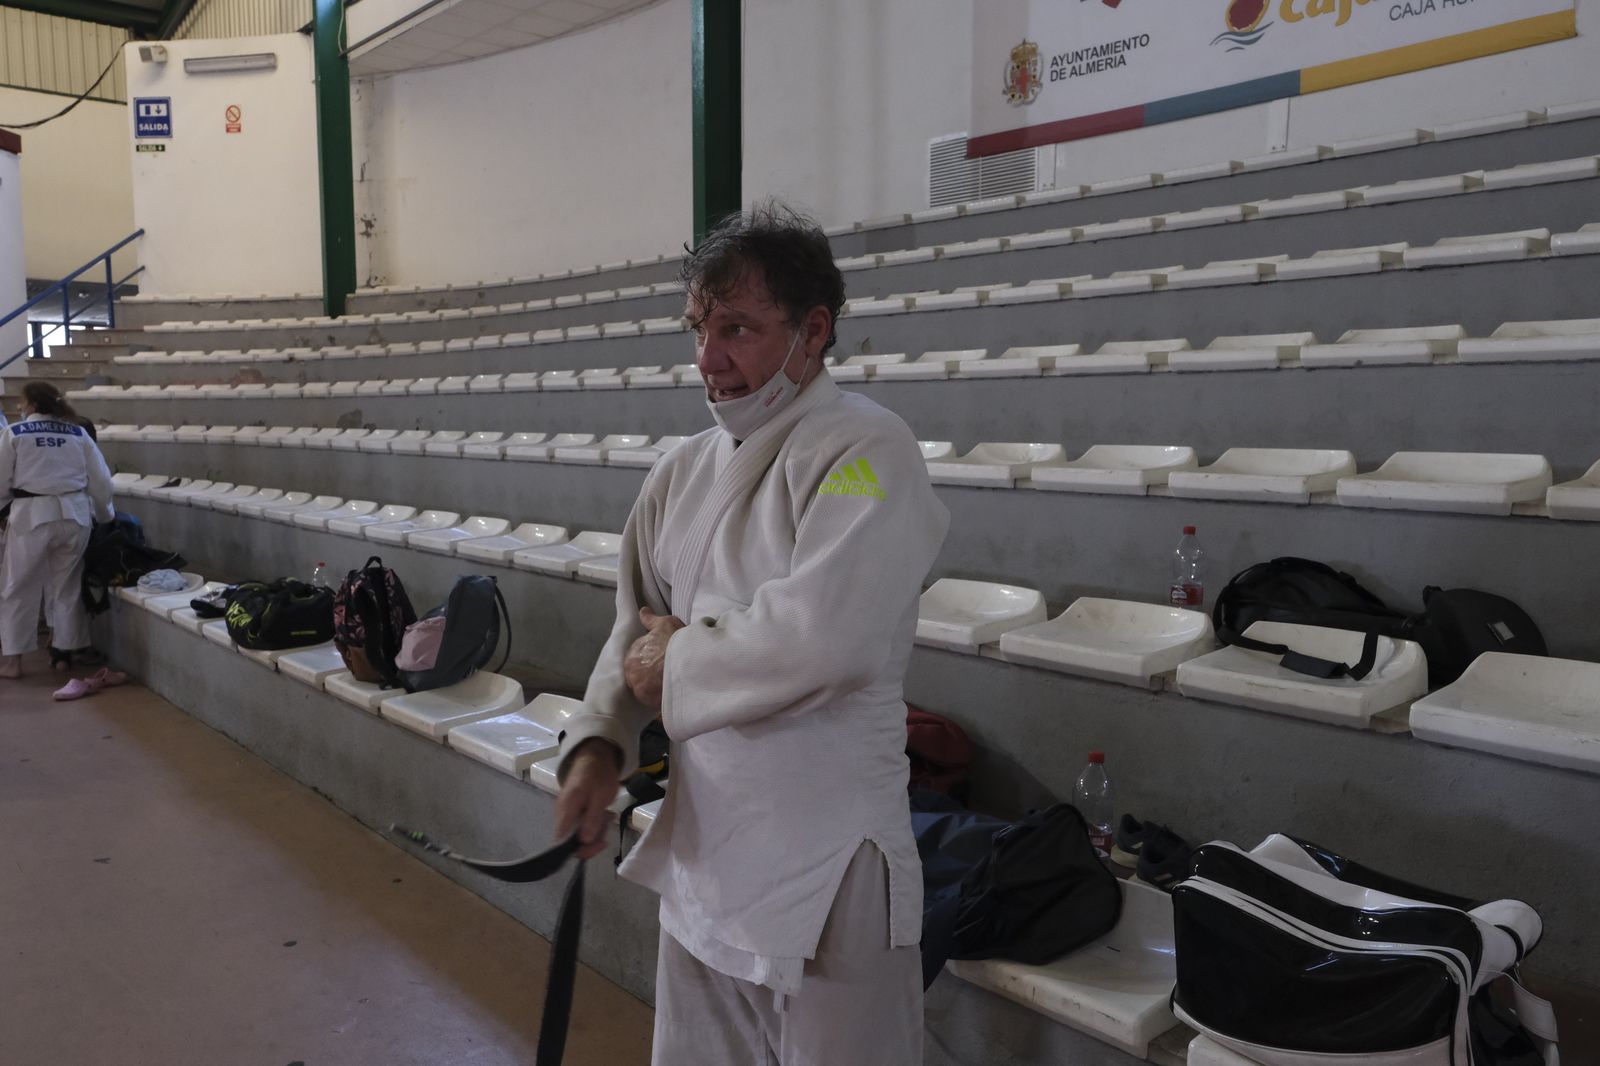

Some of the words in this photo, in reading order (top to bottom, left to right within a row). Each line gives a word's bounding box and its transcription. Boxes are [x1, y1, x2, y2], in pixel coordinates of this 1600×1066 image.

[1389, 0, 1436, 21] CAJA
[1050, 33, 1150, 69] AYUNTAMIENTO
[1050, 68, 1067, 82] DE
[138, 122, 169, 132] SALIDA
[35, 436, 66, 448] ESP
[818, 479, 887, 501] adidas
